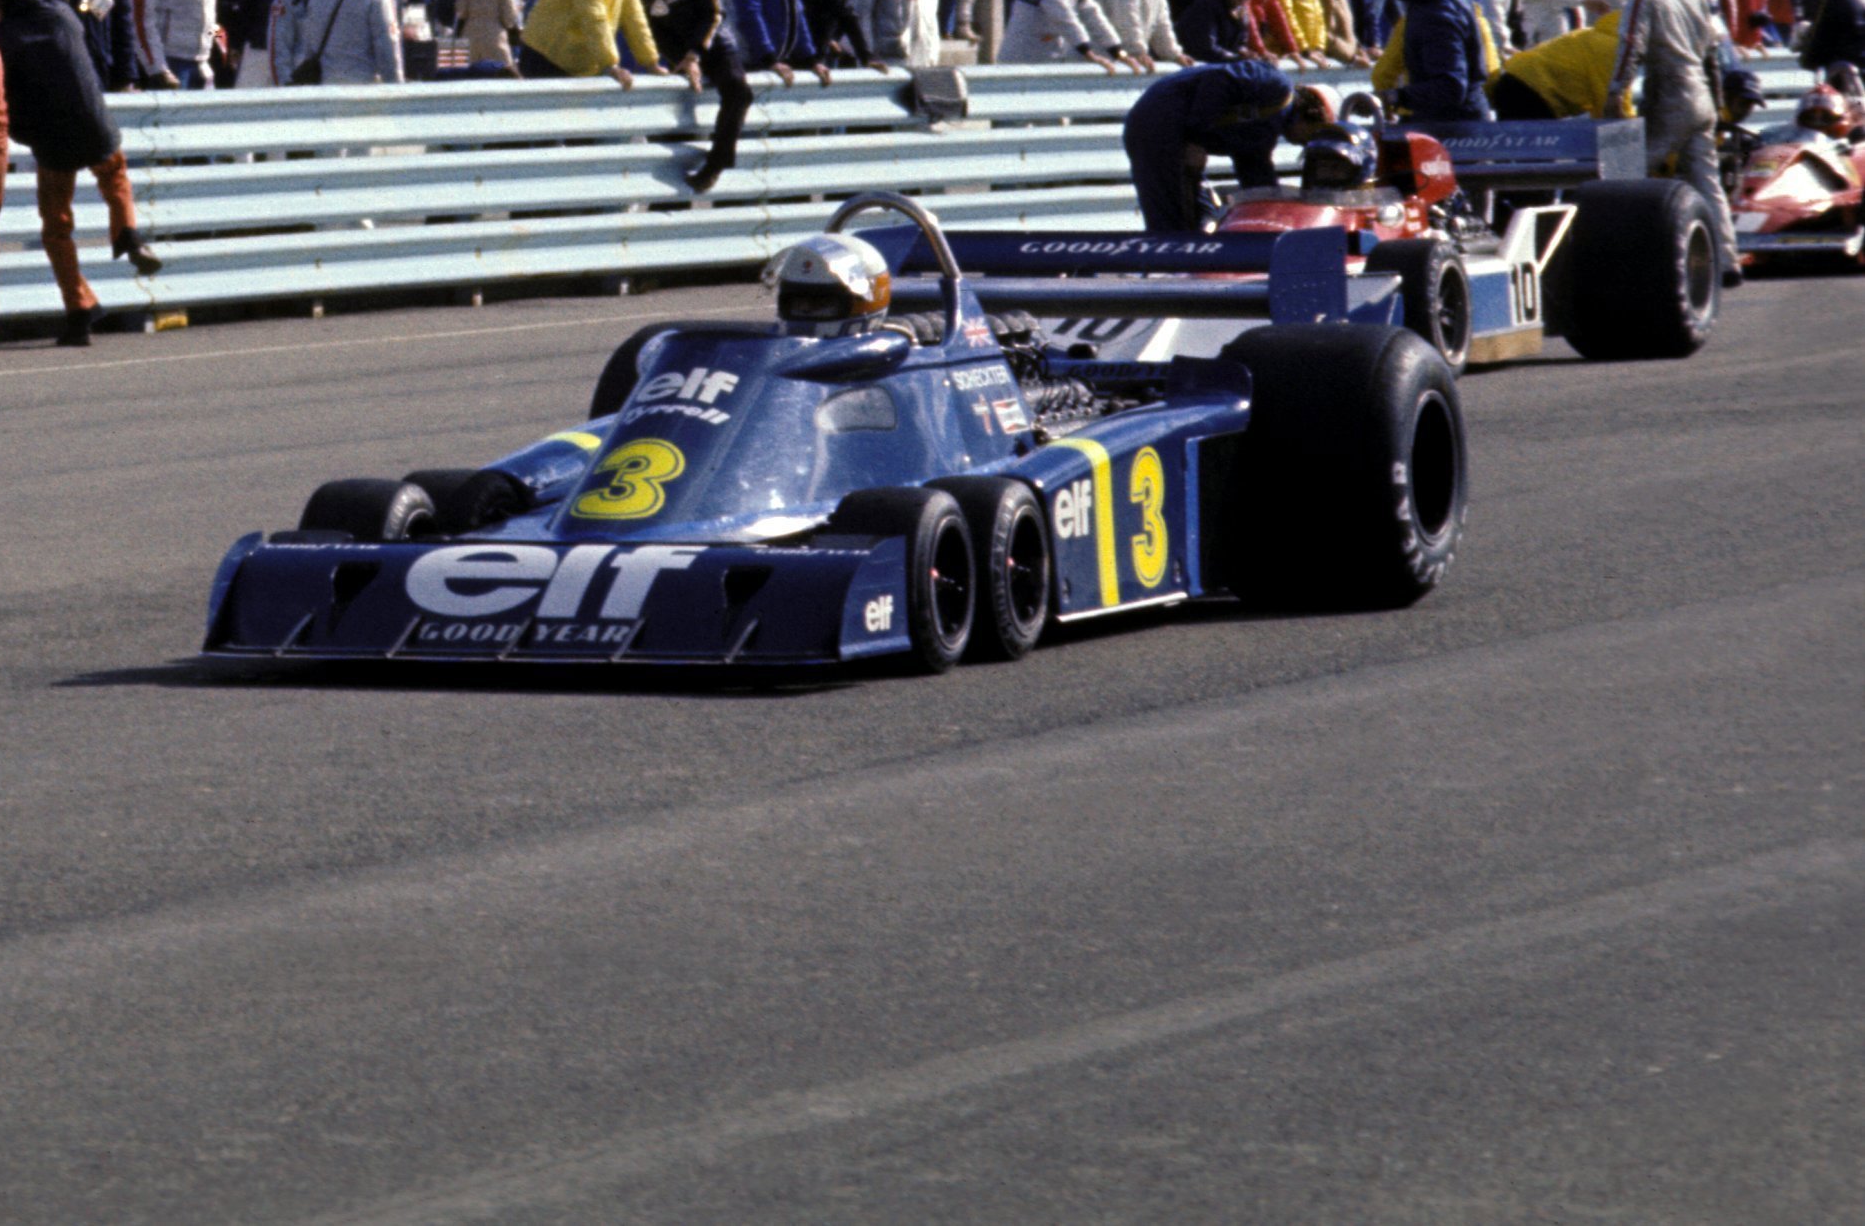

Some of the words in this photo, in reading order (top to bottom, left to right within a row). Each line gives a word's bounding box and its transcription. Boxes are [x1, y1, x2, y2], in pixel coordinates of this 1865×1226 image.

[1443, 133, 1560, 150] OODYEAR
[1020, 239, 1224, 256] GOODYEAR
[1510, 262, 1537, 324] 10
[635, 367, 740, 404] elf
[570, 438, 686, 521] 3
[1054, 479, 1092, 539] elf
[1130, 446, 1168, 588] 3
[405, 544, 710, 619] elf
[864, 594, 894, 632] elf
